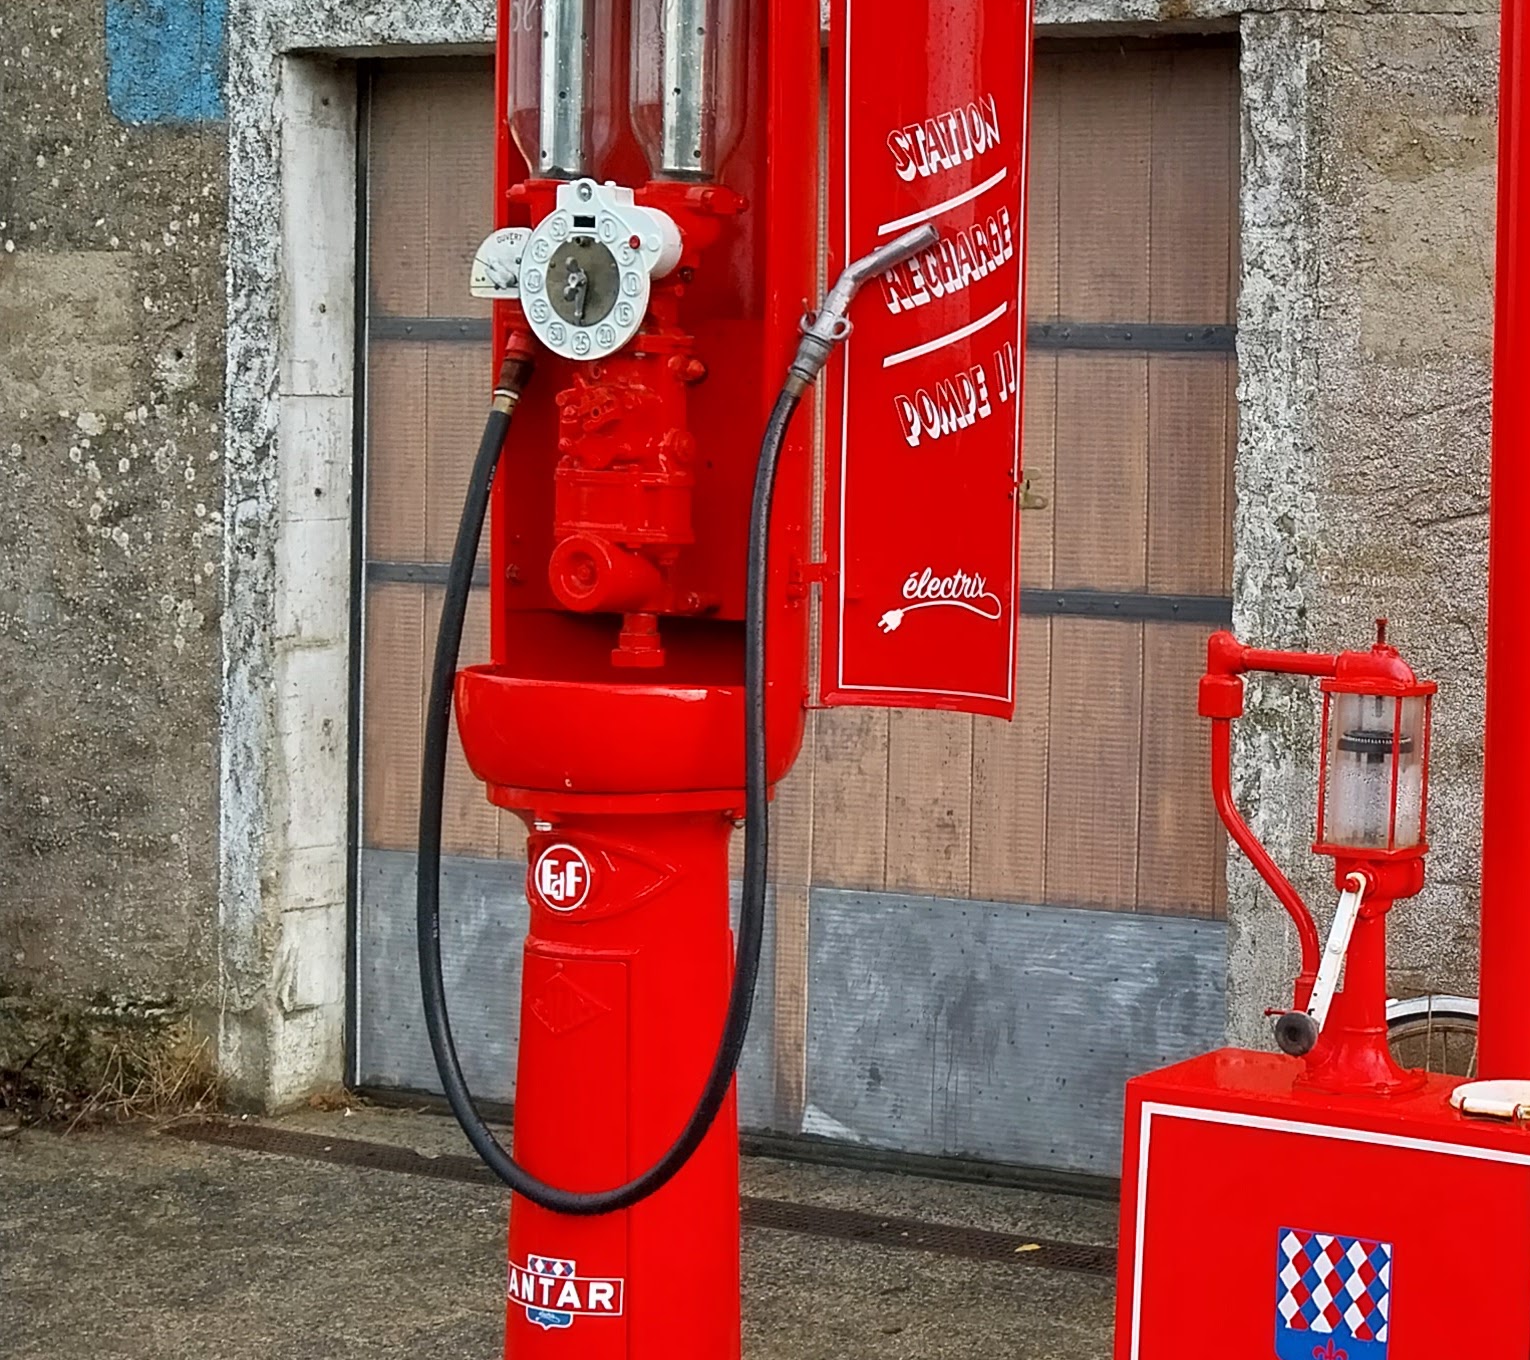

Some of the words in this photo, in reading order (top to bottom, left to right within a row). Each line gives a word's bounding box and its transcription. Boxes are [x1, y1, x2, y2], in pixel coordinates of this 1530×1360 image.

[886, 92, 1001, 182] STATION
[874, 205, 1013, 315] RECHARGE
[574, 334, 588, 352] 25
[894, 364, 993, 447] POMPE
[901, 566, 988, 600] électrix
[508, 1267, 615, 1310] ANTAR
